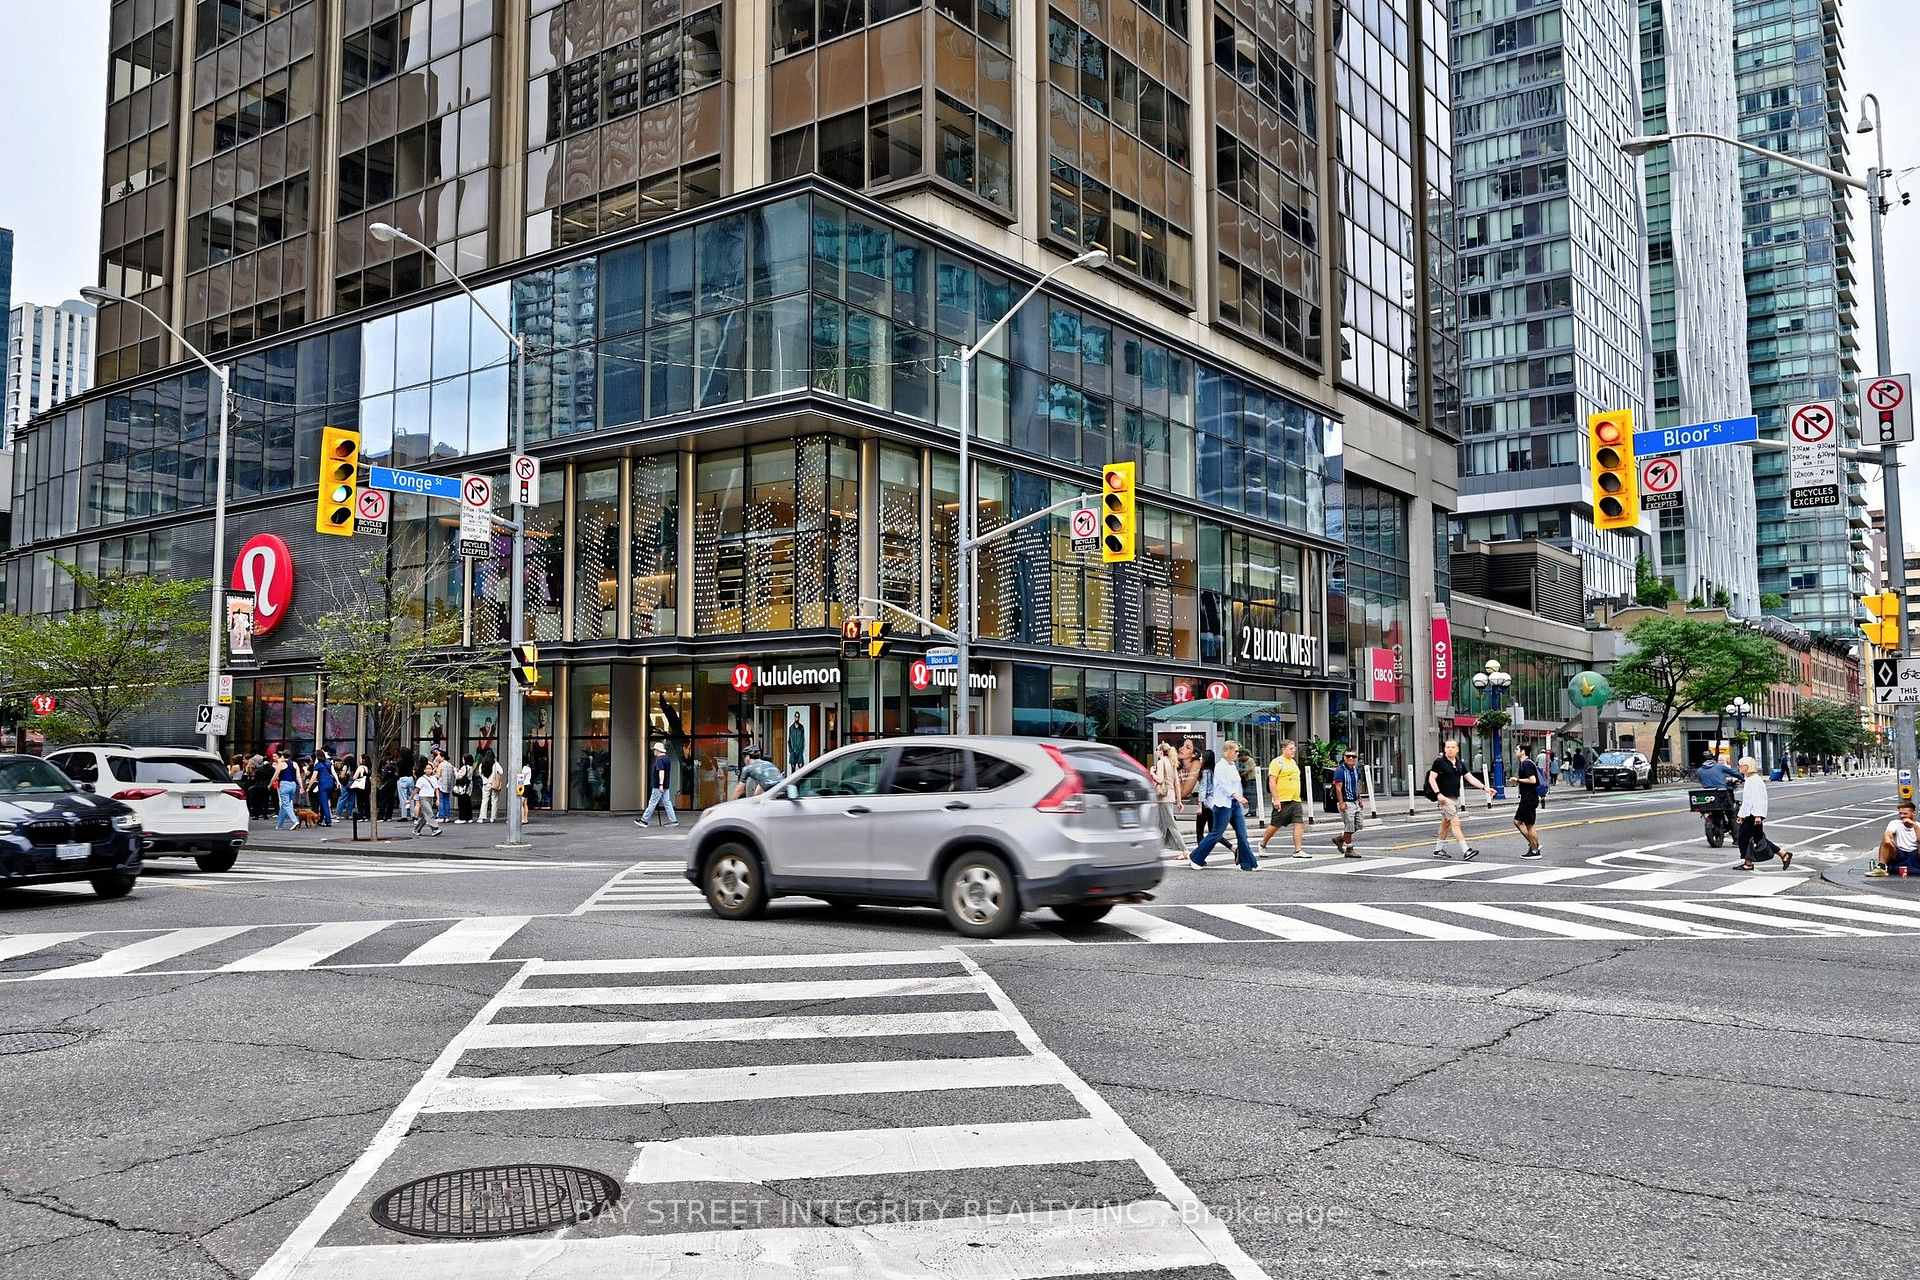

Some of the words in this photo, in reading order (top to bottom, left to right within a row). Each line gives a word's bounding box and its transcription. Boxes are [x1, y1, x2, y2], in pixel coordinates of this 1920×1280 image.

[1664, 428, 1710, 447] Bloor
[1713, 424, 1722, 433] St
[391, 471, 432, 492] Yonge
[436, 478, 443, 486] St
[1646, 493, 1677, 502] BICYCLES
[1795, 487, 1834, 498] BICYCLES
[1646, 500, 1678, 510] EXCEPTED
[1793, 496, 1836, 507] EXCEPTED
[359, 519, 383, 528] BICYCLES
[357, 525, 383, 535] EXCEPTED
[463, 541, 487, 549] BICYCLES
[462, 547, 488, 556] EXCEPTED
[1242, 625, 1250, 659] 2
[1253, 627, 1288, 664] BLOOR
[1289, 632, 1317, 668] WEST
[1437, 652, 1447, 680] CIBC
[757, 664, 841, 687] lululemon
[932, 667, 997, 689] lulumon
[1374, 667, 1389, 682] CIBC
[1900, 687, 1918, 695] THIS
[1898, 695, 1919, 703] LANE
